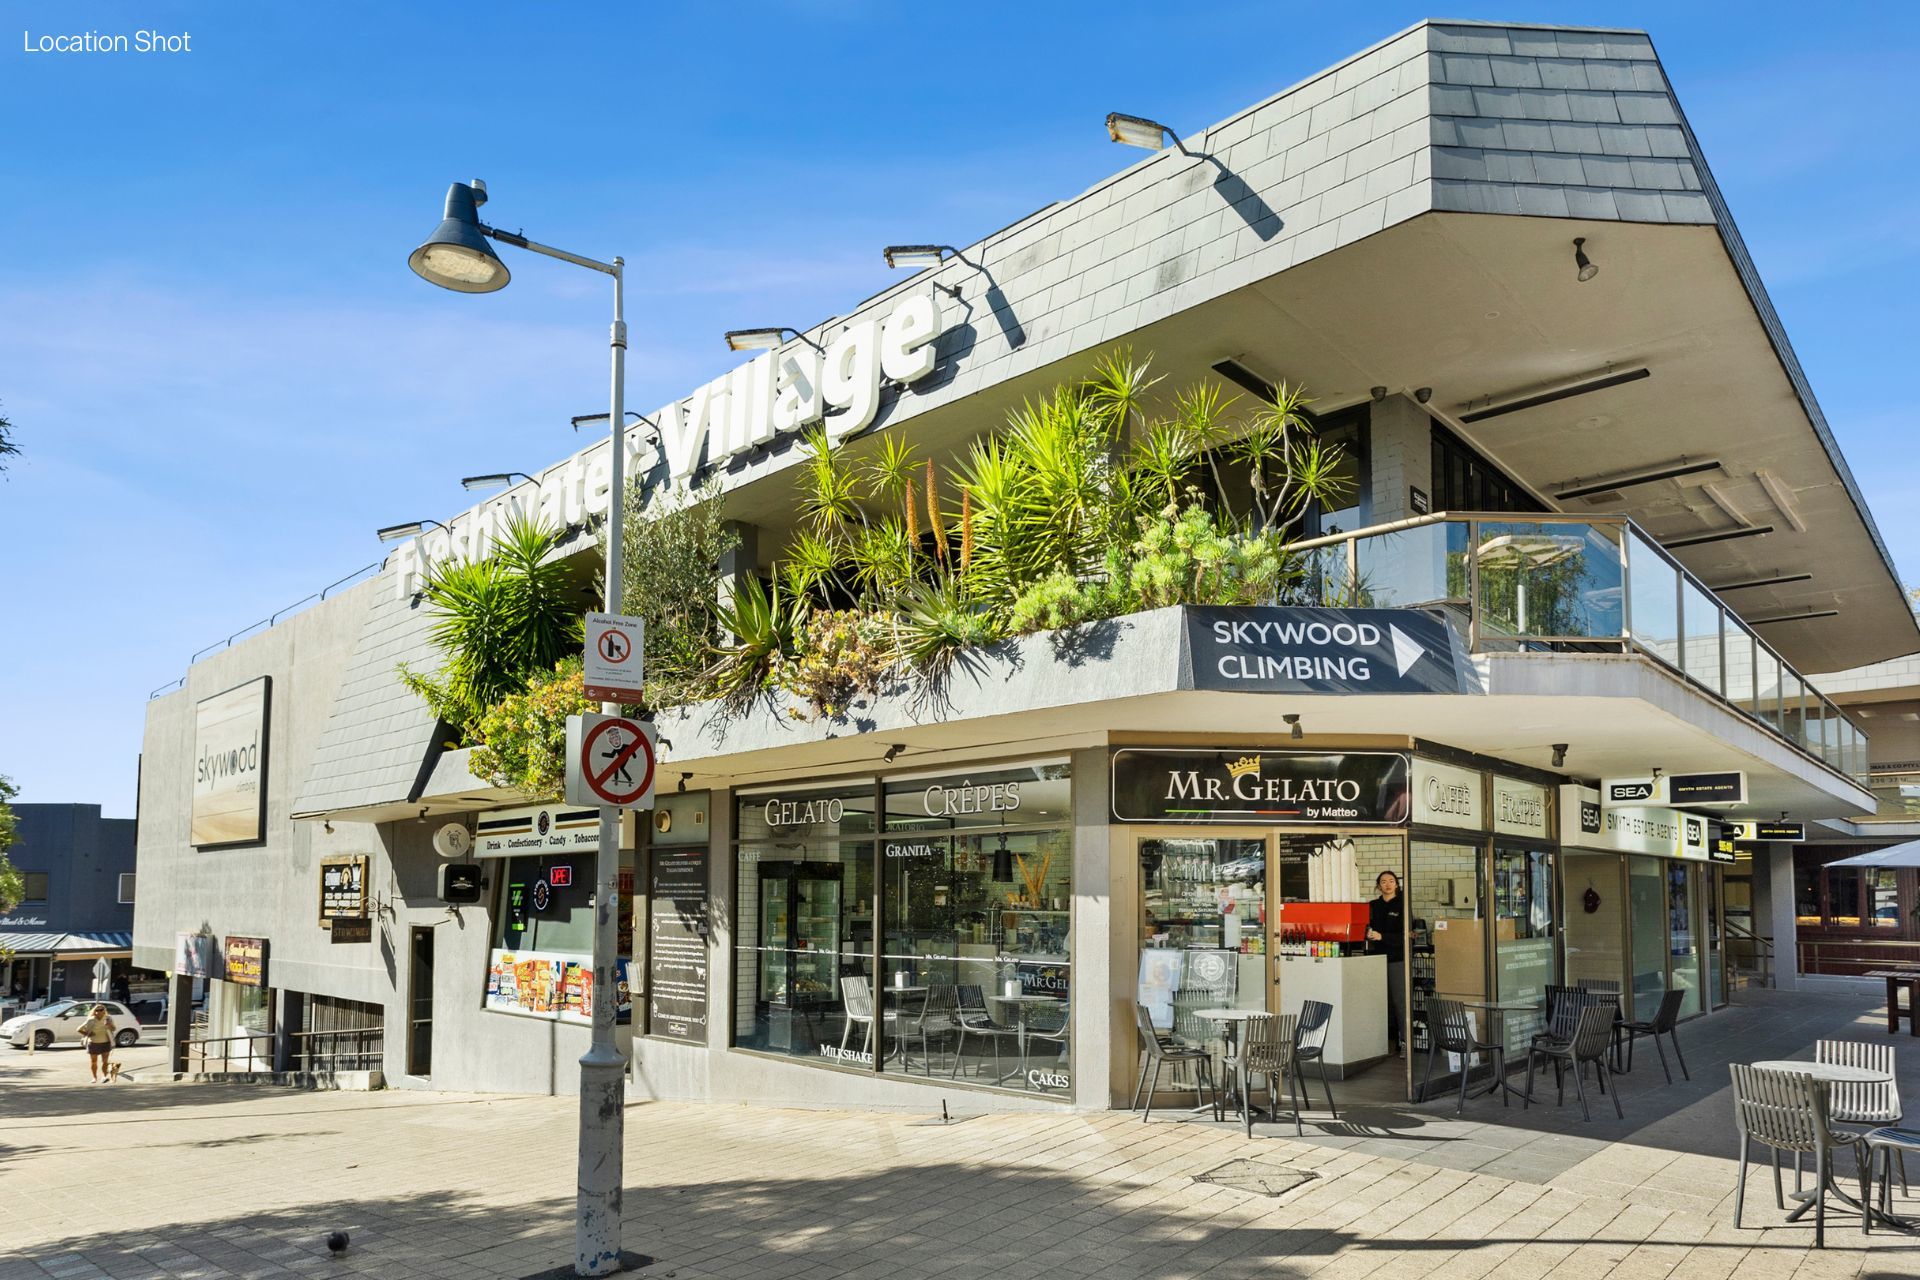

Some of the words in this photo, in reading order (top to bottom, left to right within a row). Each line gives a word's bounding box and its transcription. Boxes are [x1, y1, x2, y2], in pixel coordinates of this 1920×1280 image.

[660, 295, 942, 480] Village
[1213, 620, 1381, 646] SKYWOOD
[1217, 655, 1371, 681] CLIMBING
[198, 728, 258, 791] skywood
[923, 779, 1021, 817] CRÊPES
[1164, 770, 1230, 801] MR.
[1232, 770, 1361, 804] GELATO
[1614, 786, 1650, 798] SEA
[764, 798, 844, 827] GELATO
[1307, 807, 1319, 818] by
[1322, 807, 1358, 817] Matteo
[1582, 808, 1600, 828] SEA
[1607, 813, 1631, 832] SMYTH
[1634, 818, 1655, 838] ESTATE
[1656, 823, 1678, 841] AGENTS
[1688, 823, 1700, 842] SEA
[486, 840, 502, 850] Drink
[508, 838, 543, 849] Confectionery
[549, 836, 566, 846] Candy
[886, 843, 932, 857] GRANITA
[820, 1044, 872, 1064] MILKSHAKE
[1028, 1070, 1069, 1088] CAKES
